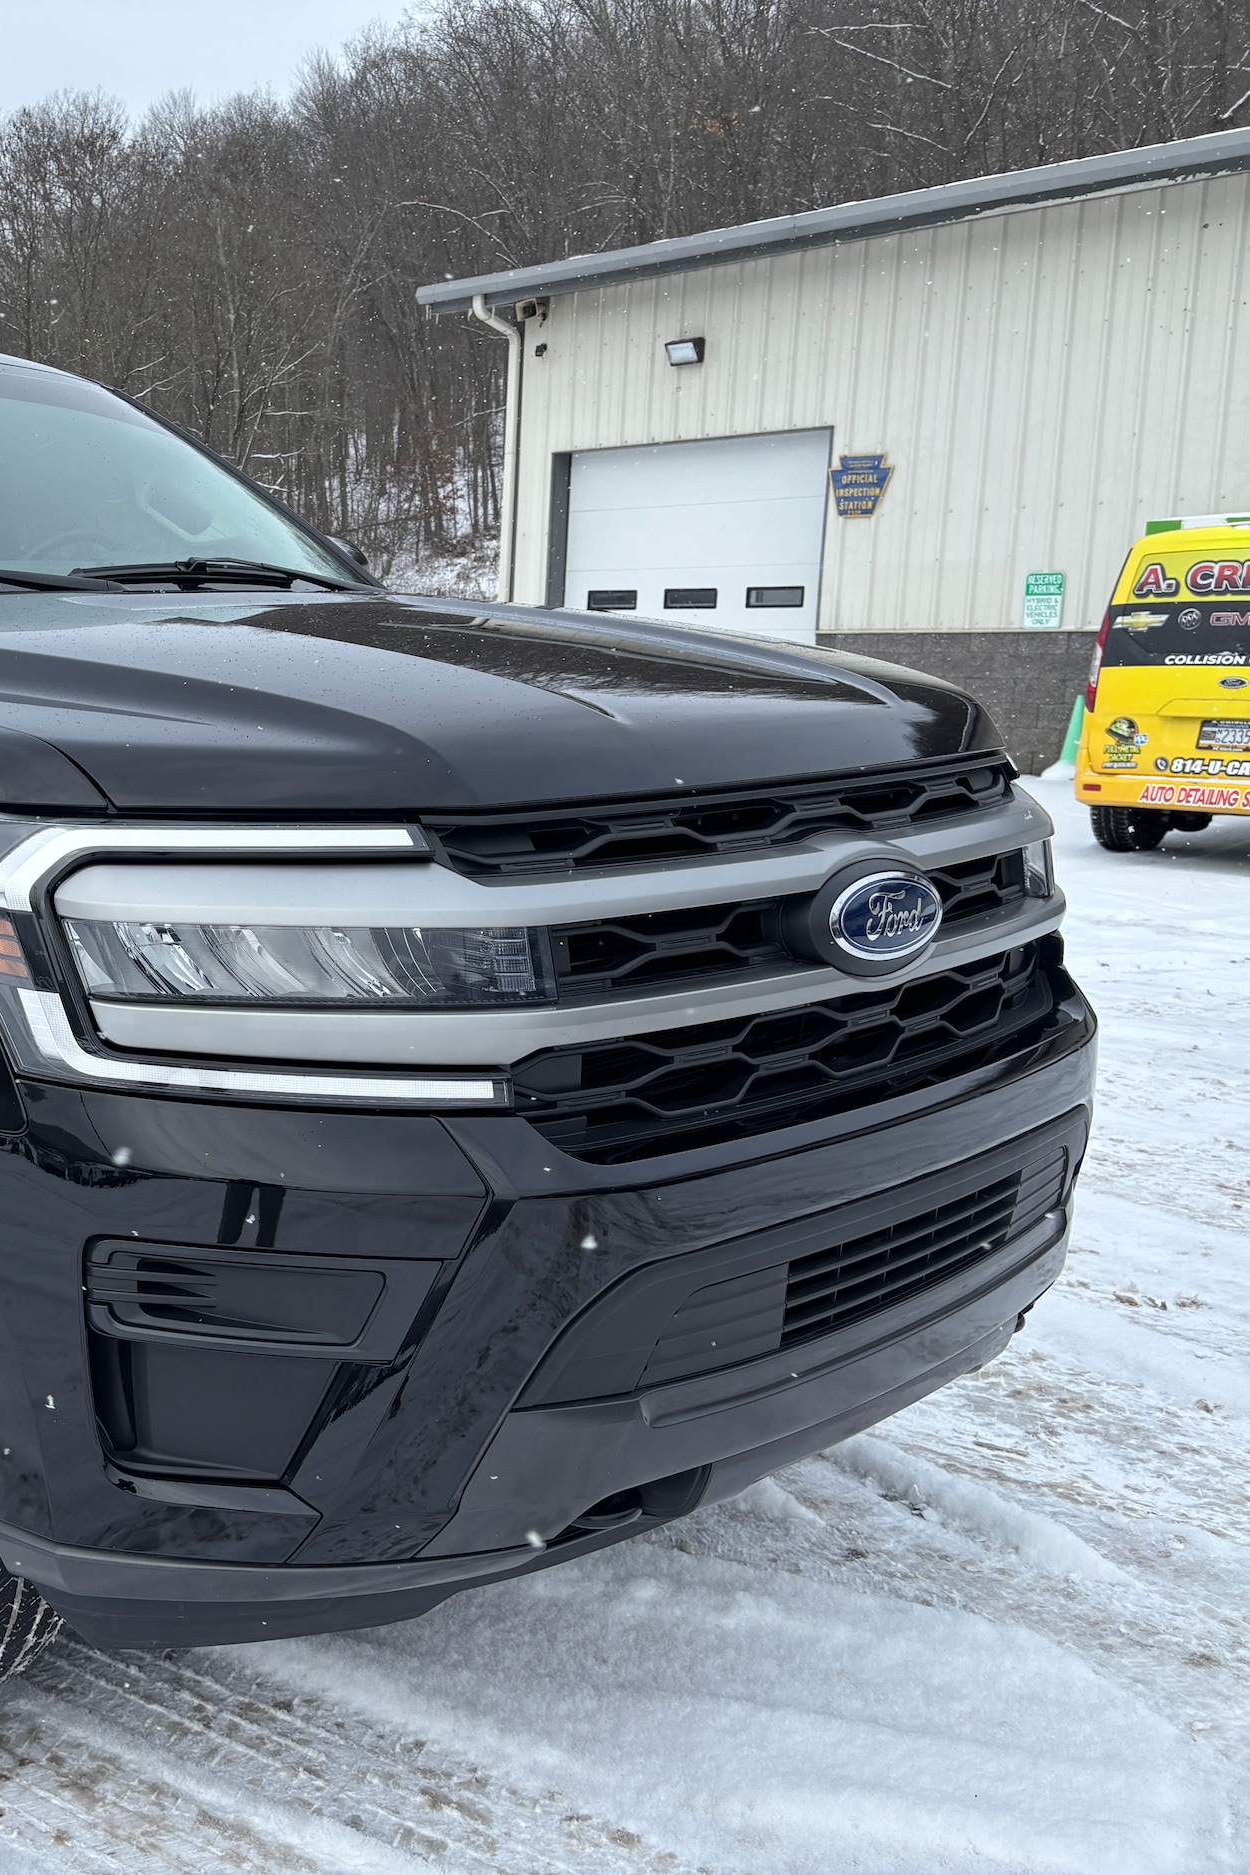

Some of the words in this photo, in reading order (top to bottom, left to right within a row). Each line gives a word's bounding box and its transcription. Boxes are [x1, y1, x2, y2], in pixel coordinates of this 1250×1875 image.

[841, 474, 878, 484] OFFICIAL
[836, 487, 880, 497] INSPECTION
[839, 500, 873, 510] STATION
[1028, 574, 1062, 584] RESERVED
[1134, 564, 1178, 596] A.
[1029, 584, 1061, 594] PARKING
[1164, 655, 1246, 665] COLLISION
[1139, 785, 1175, 803] AUTO
[1176, 787, 1240, 806] DETAILING
[866, 890, 923, 941] Ford
